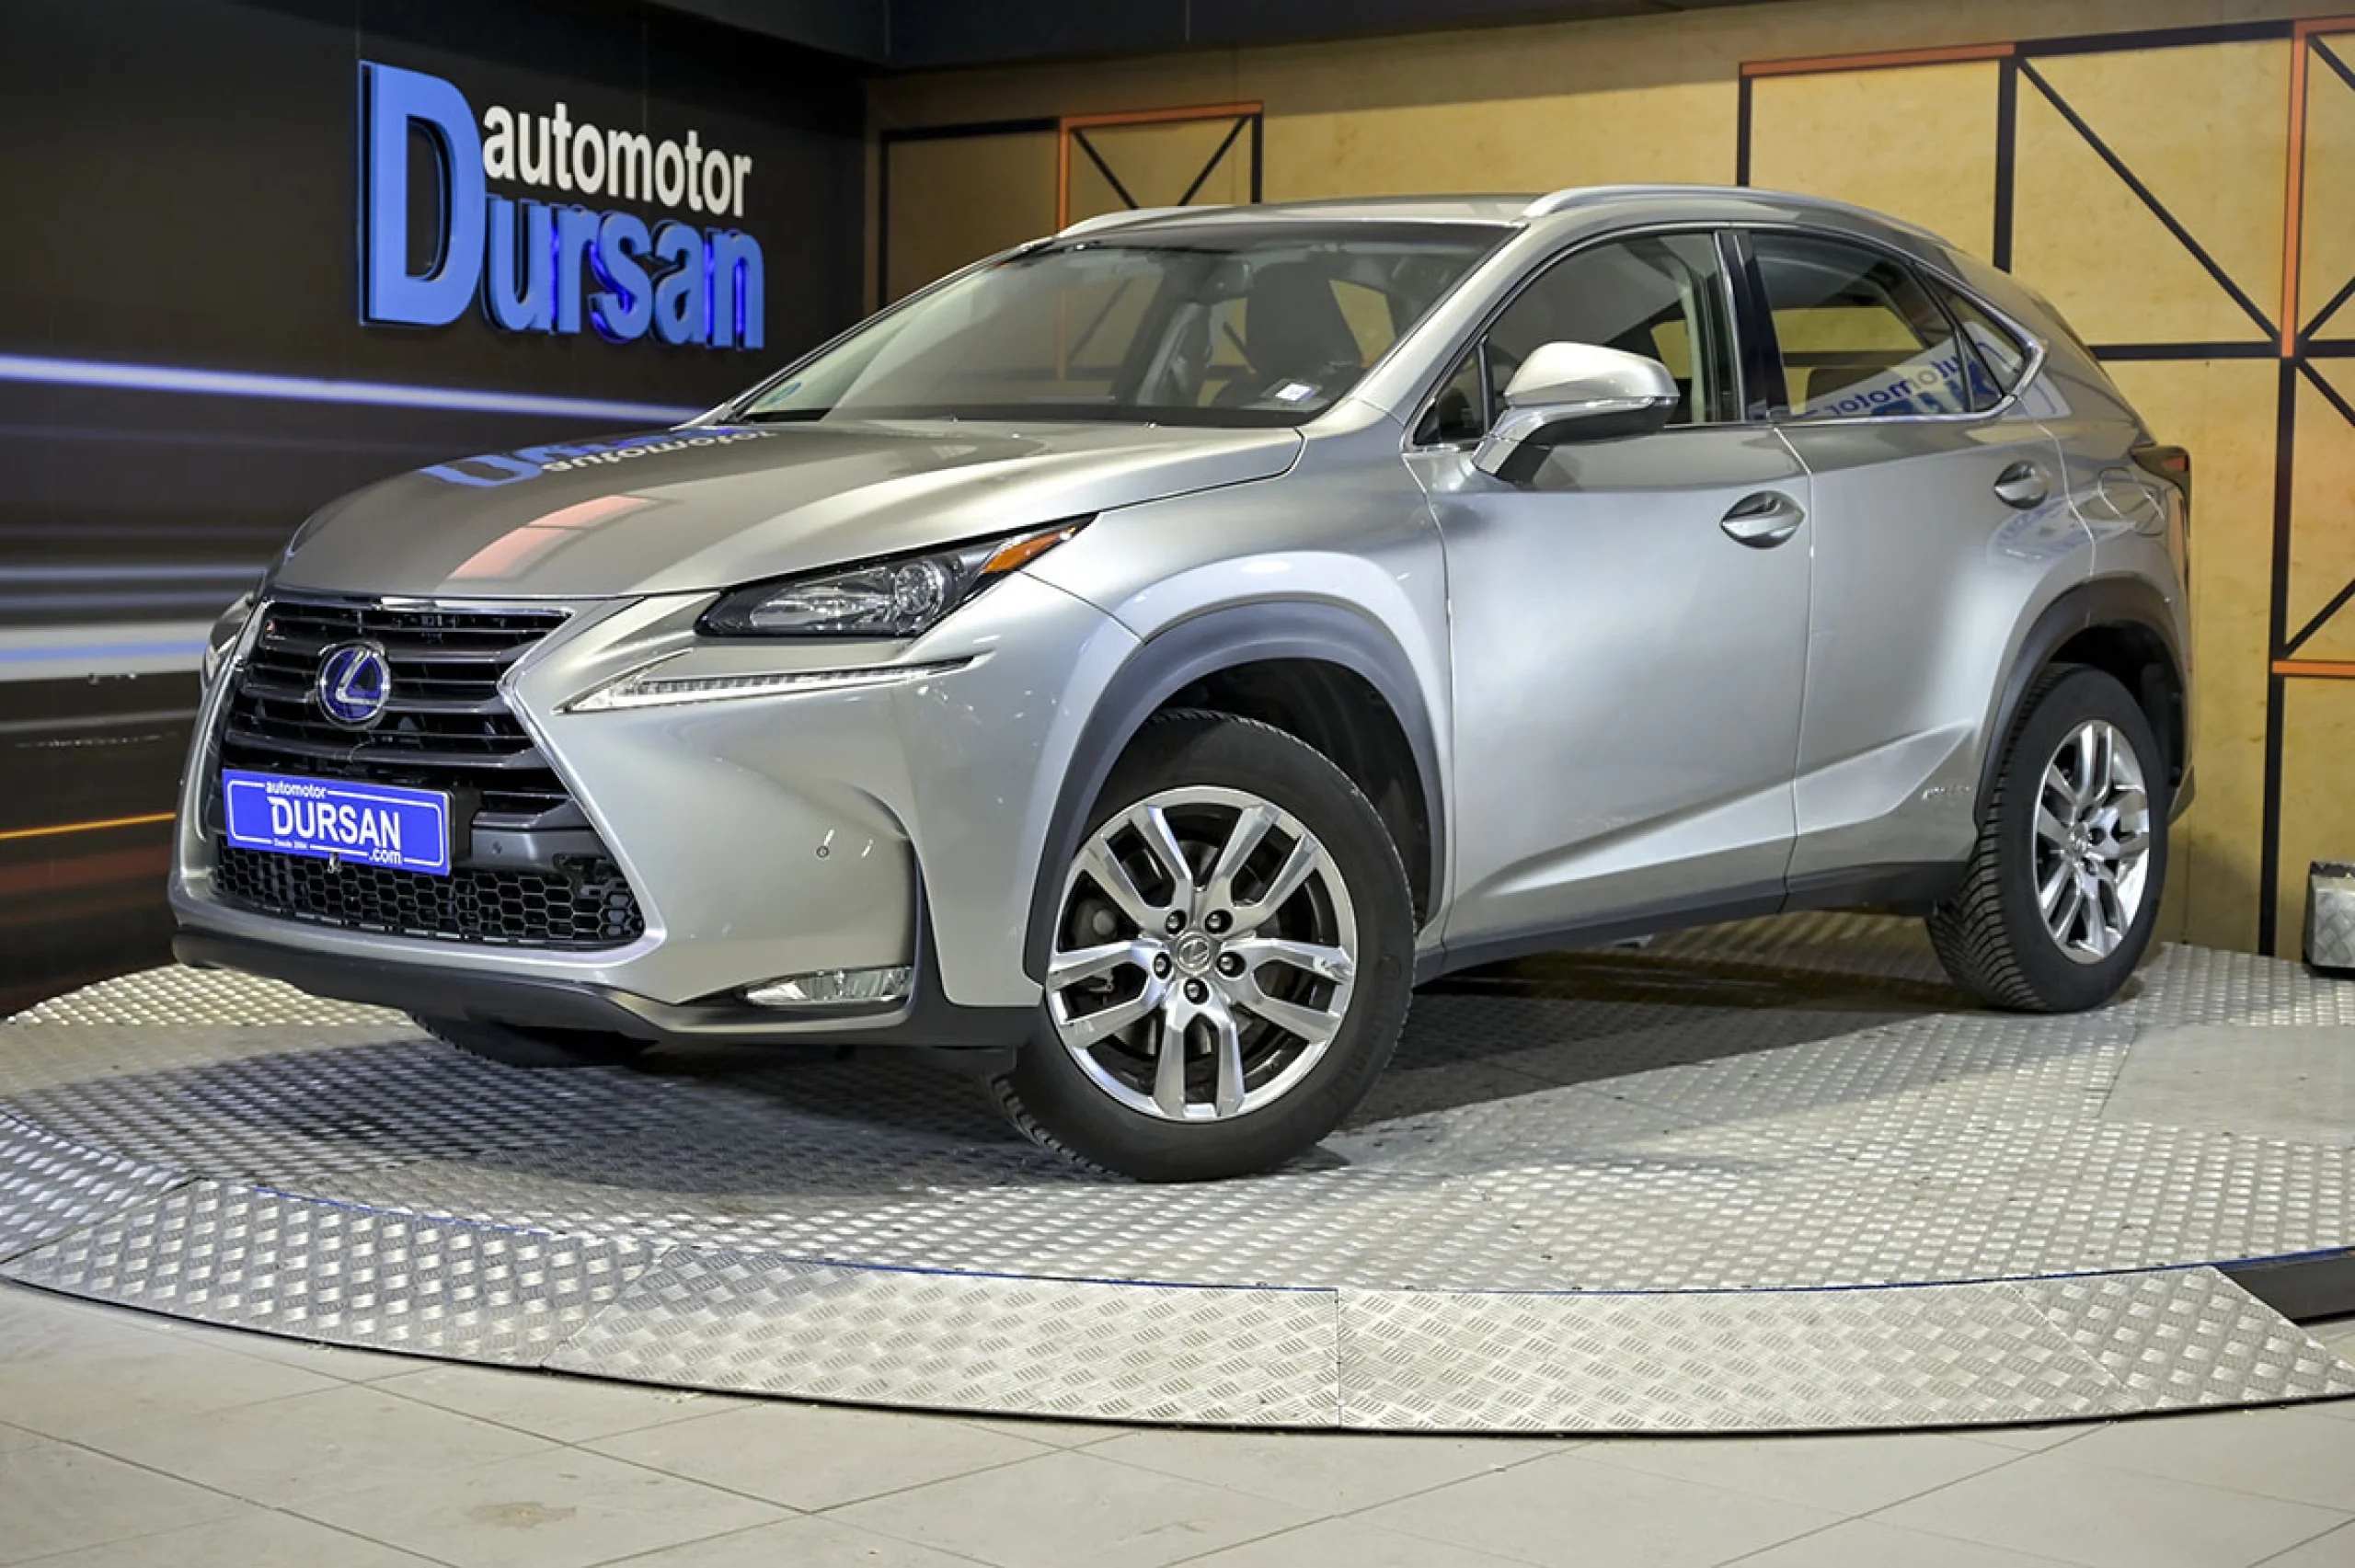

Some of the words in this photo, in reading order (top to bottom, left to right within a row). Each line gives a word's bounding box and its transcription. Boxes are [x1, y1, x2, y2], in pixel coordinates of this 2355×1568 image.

[483, 102, 752, 217] automotor
[358, 60, 764, 350] Dursan
[265, 781, 327, 799] automotor
[267, 796, 401, 851] DURSAN
[369, 847, 403, 864] .com
